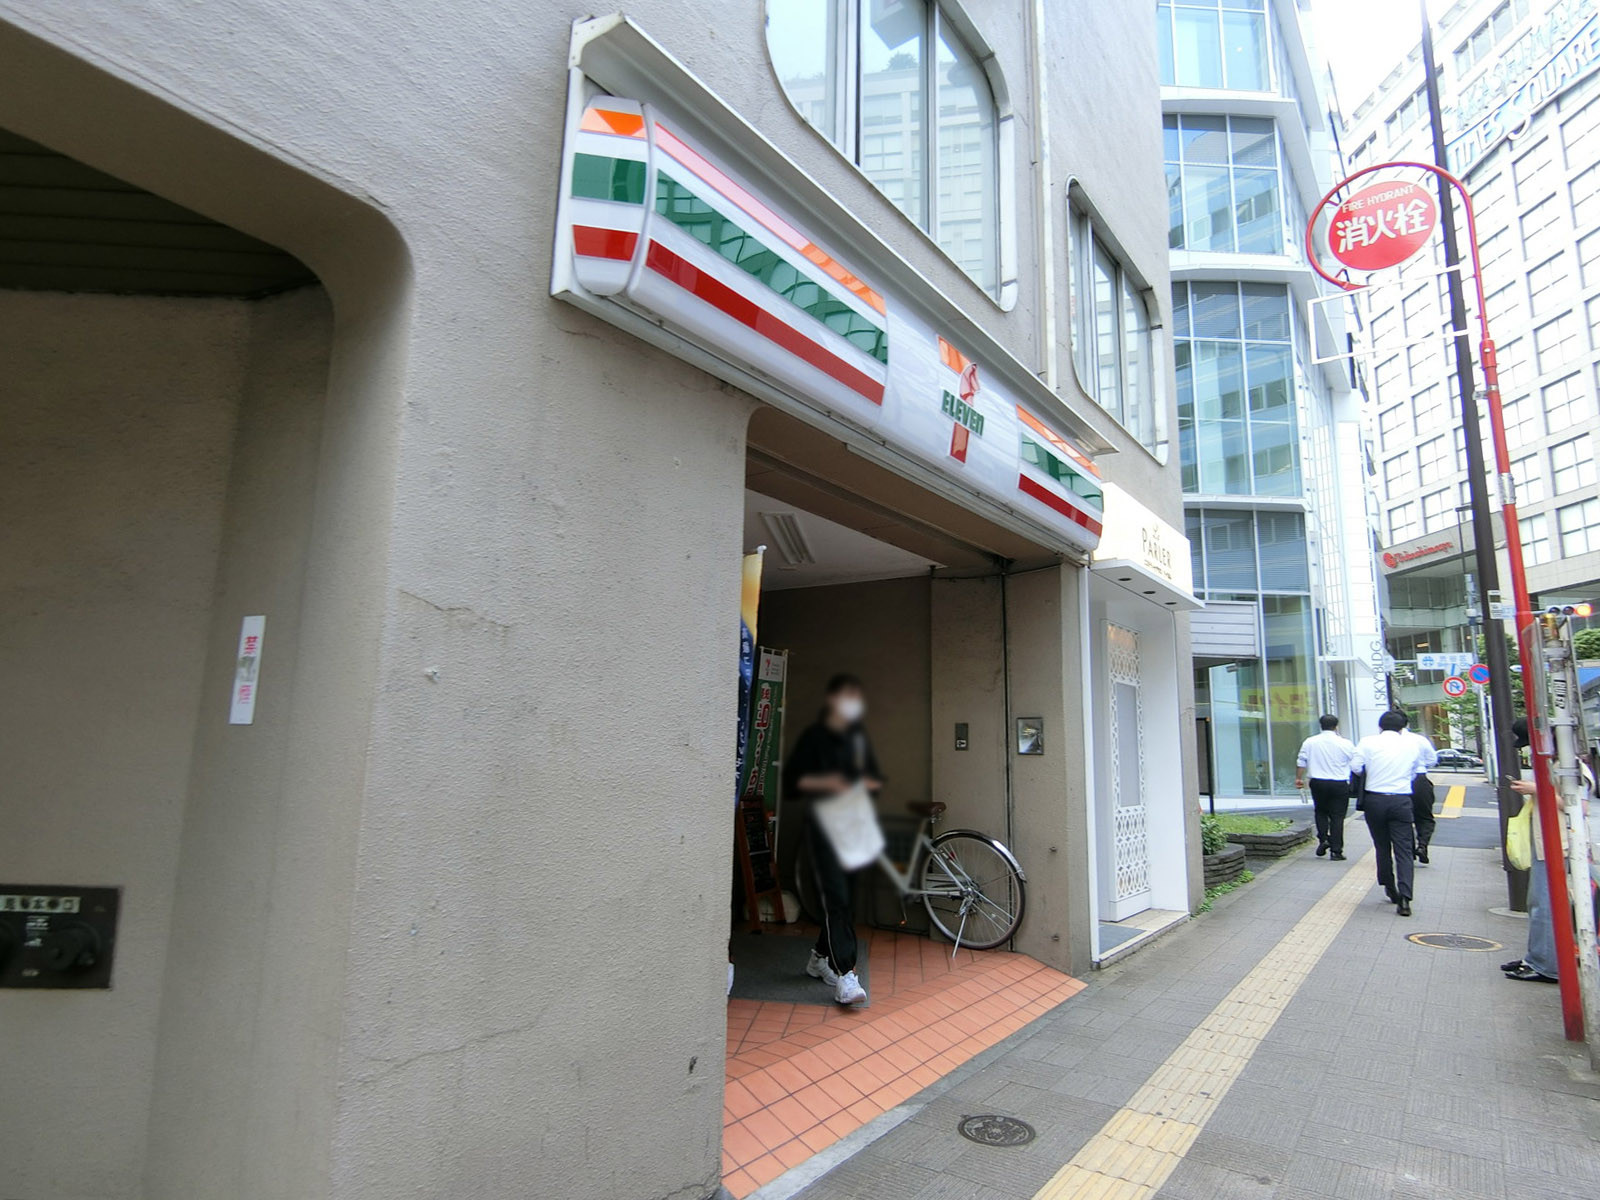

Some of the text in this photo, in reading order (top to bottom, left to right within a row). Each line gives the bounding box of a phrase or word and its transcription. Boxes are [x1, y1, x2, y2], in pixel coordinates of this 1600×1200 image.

[1449, 26, 1600, 175] TIMES SQUARE
[1341, 184, 1415, 214] FIRE HYDRANT
[1334, 198, 1430, 254] 消火栓
[1141, 527, 1172, 569] PARLER
